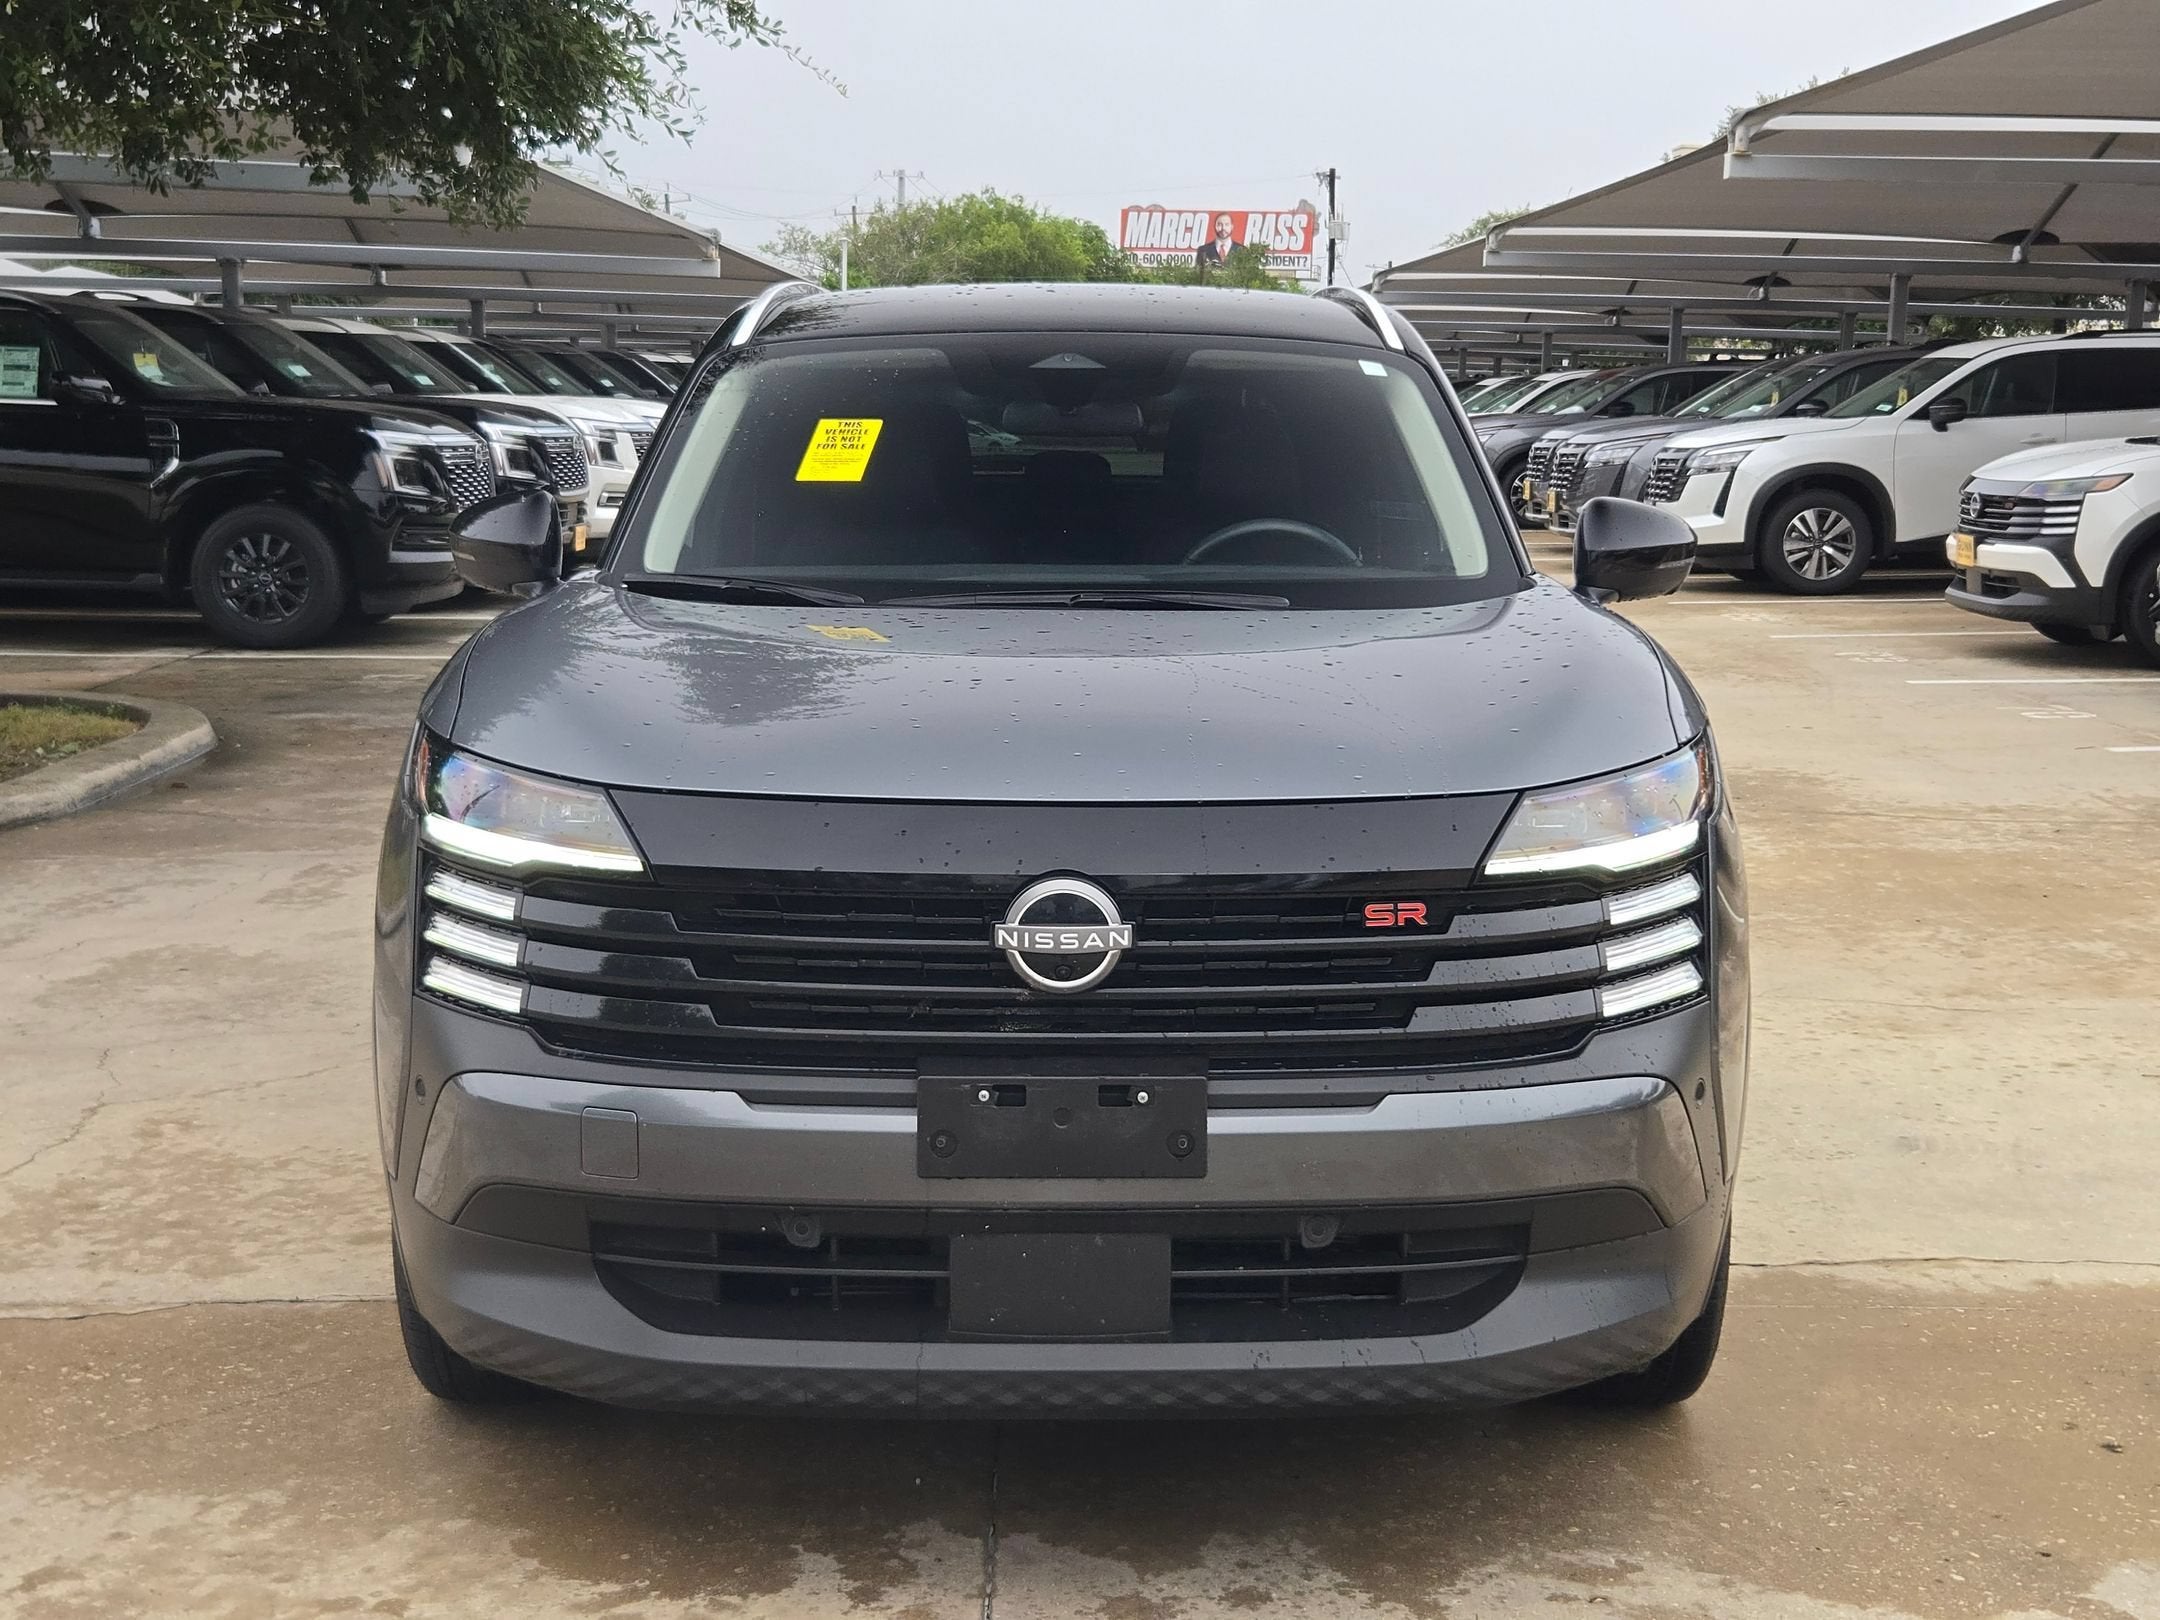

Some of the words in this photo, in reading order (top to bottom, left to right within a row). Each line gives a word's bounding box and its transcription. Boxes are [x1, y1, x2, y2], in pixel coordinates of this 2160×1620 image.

[1124, 211, 1209, 249] MARCO
[1364, 902, 1428, 927] SR
[998, 929, 1129, 949] NISSAN
